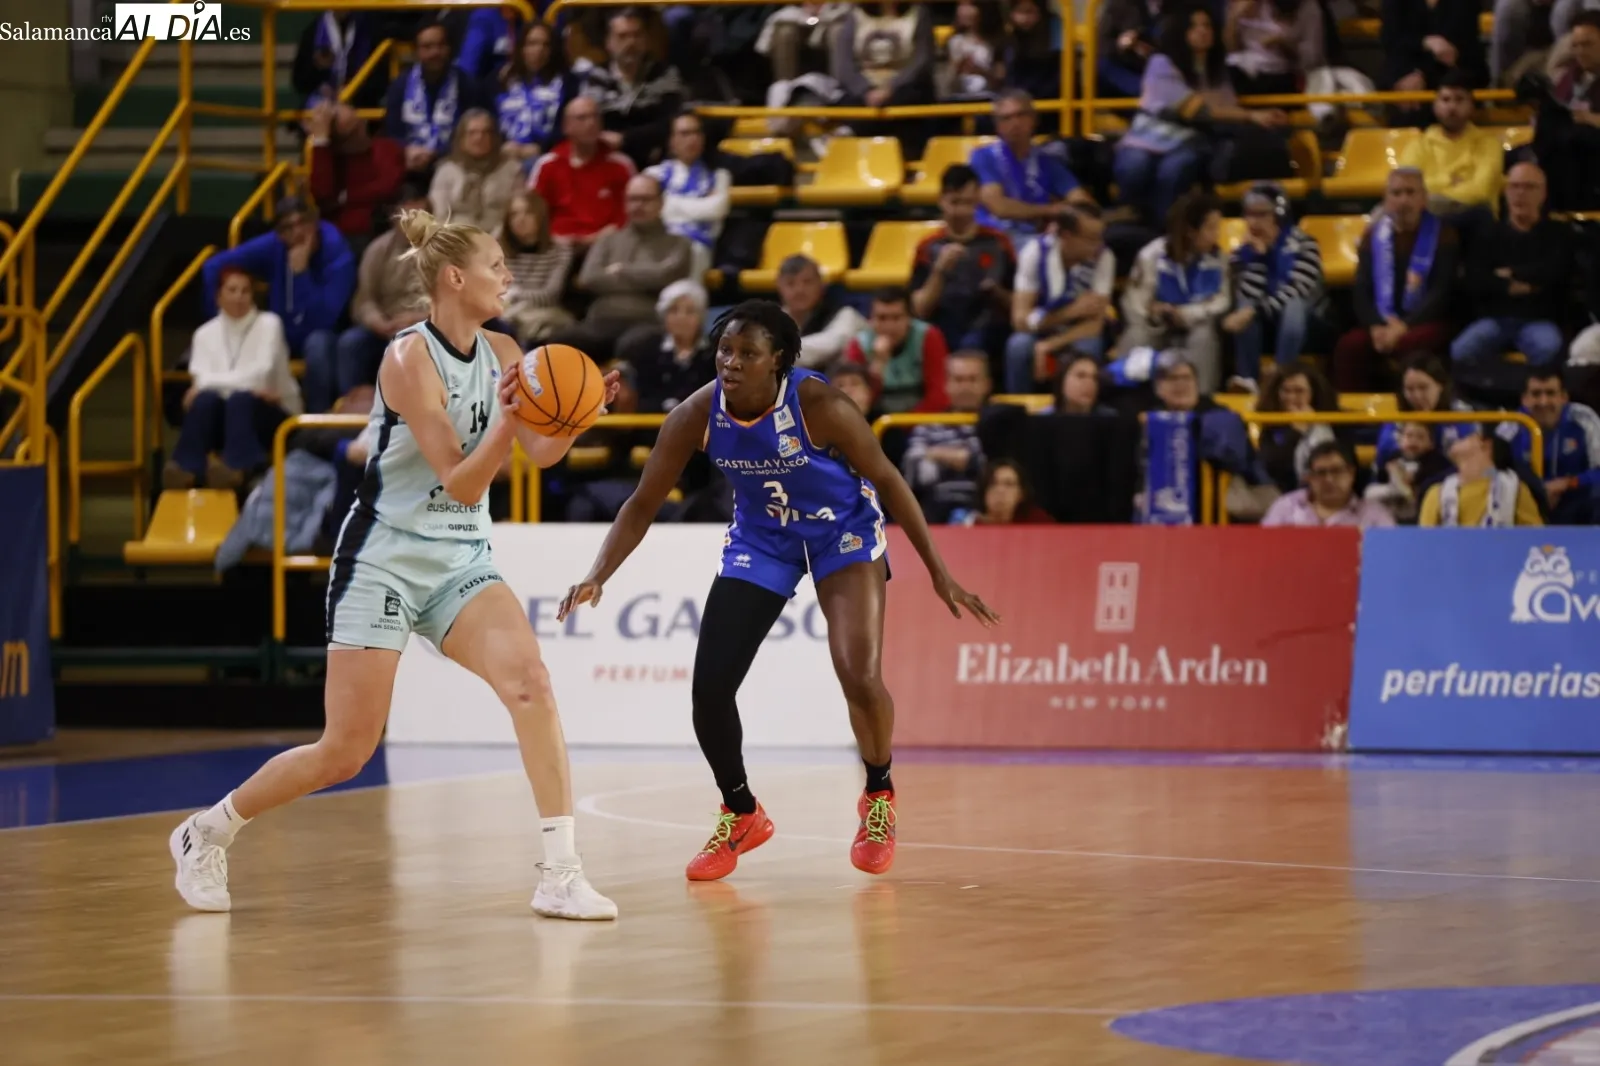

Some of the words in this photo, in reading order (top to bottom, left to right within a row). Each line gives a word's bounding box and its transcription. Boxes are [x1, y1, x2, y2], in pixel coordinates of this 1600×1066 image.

[470, 400, 489, 434] 14
[715, 458, 771, 469] CASTILLA
[772, 459, 781, 469] Y
[763, 480, 789, 507] 3
[956, 643, 1141, 685] Elizabeth
[1148, 643, 1268, 686] Arden
[1380, 662, 1600, 703] perfumerias
[1050, 695, 1097, 710] NEW
[1107, 695, 1168, 711] YORK
